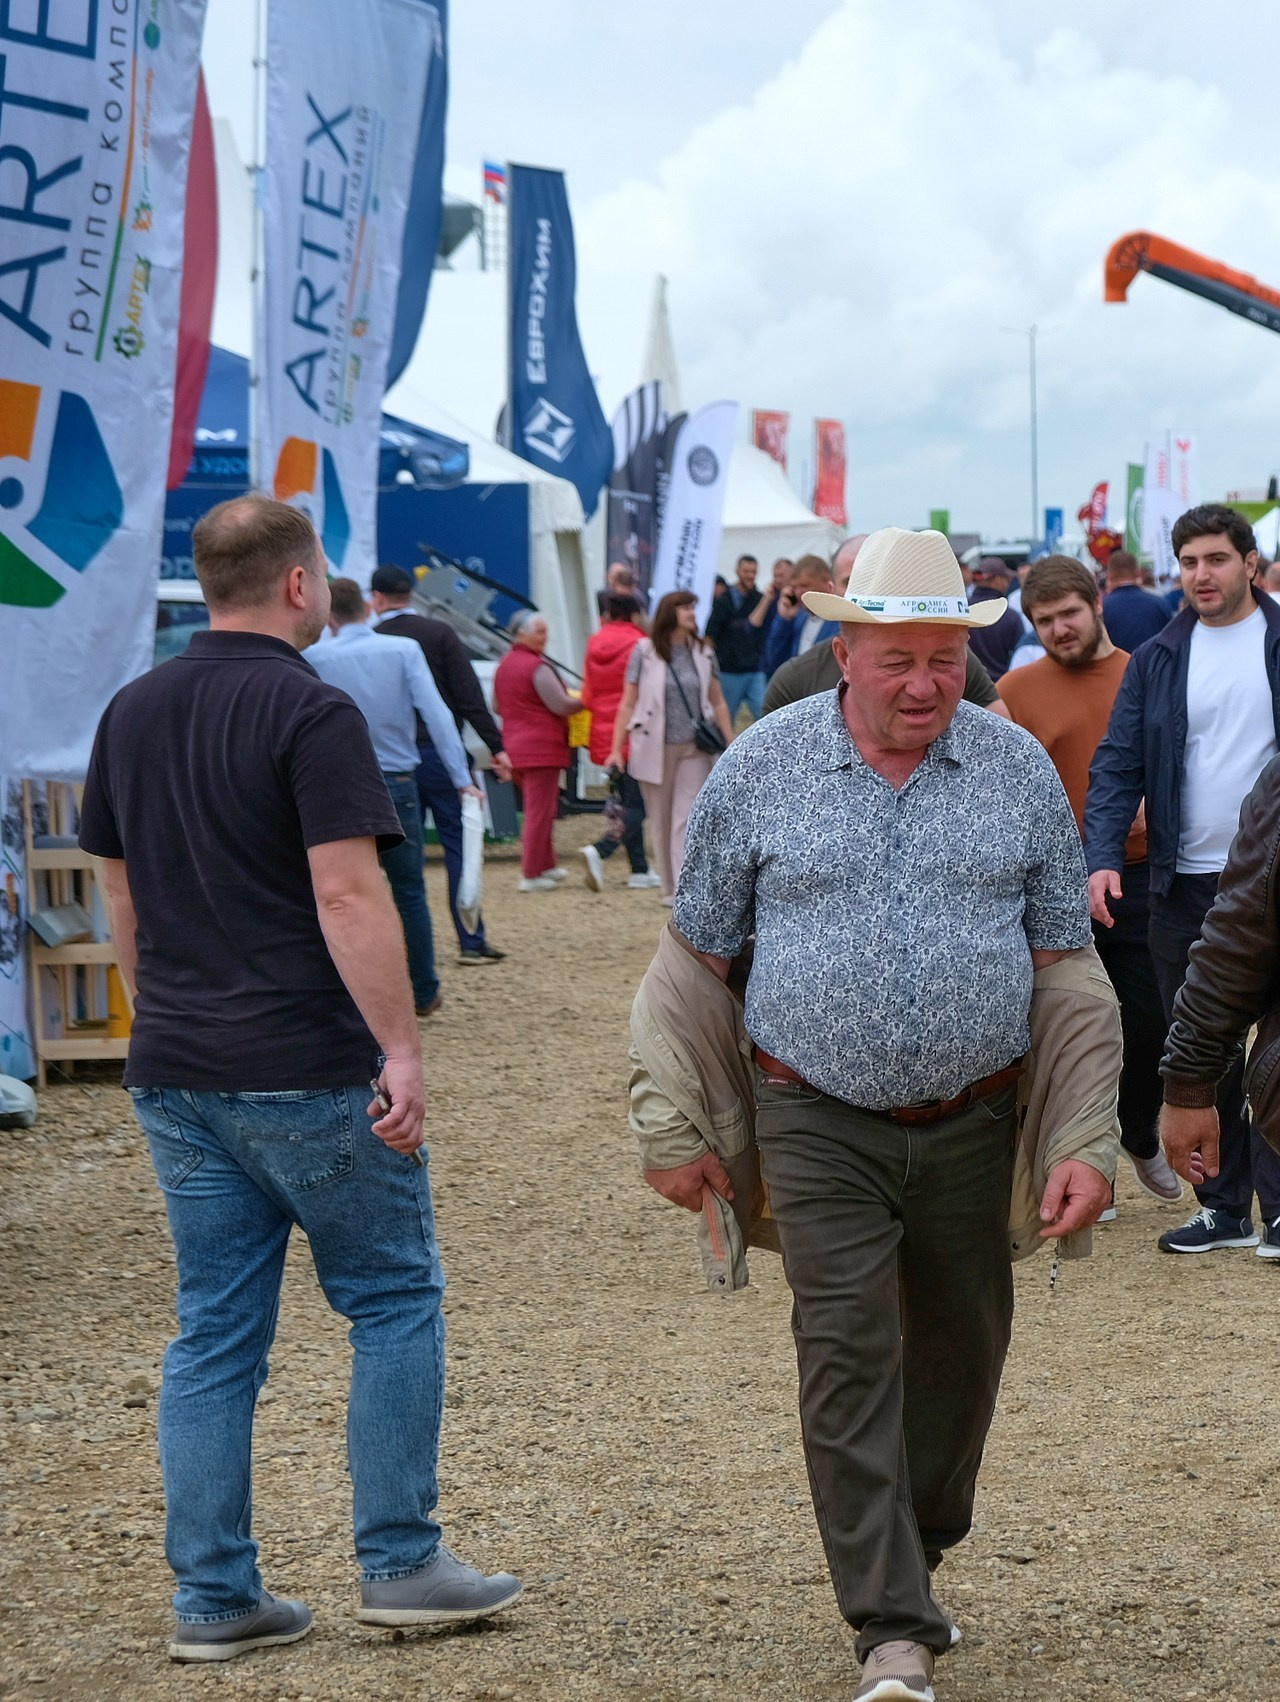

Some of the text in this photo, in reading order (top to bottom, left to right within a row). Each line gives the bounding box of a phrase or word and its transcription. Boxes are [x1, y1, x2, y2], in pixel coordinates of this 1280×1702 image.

[65, 181, 113, 356] группа
[284, 91, 353, 415] ARTEX
[526, 218, 552, 385] ЕВРОХИМ
